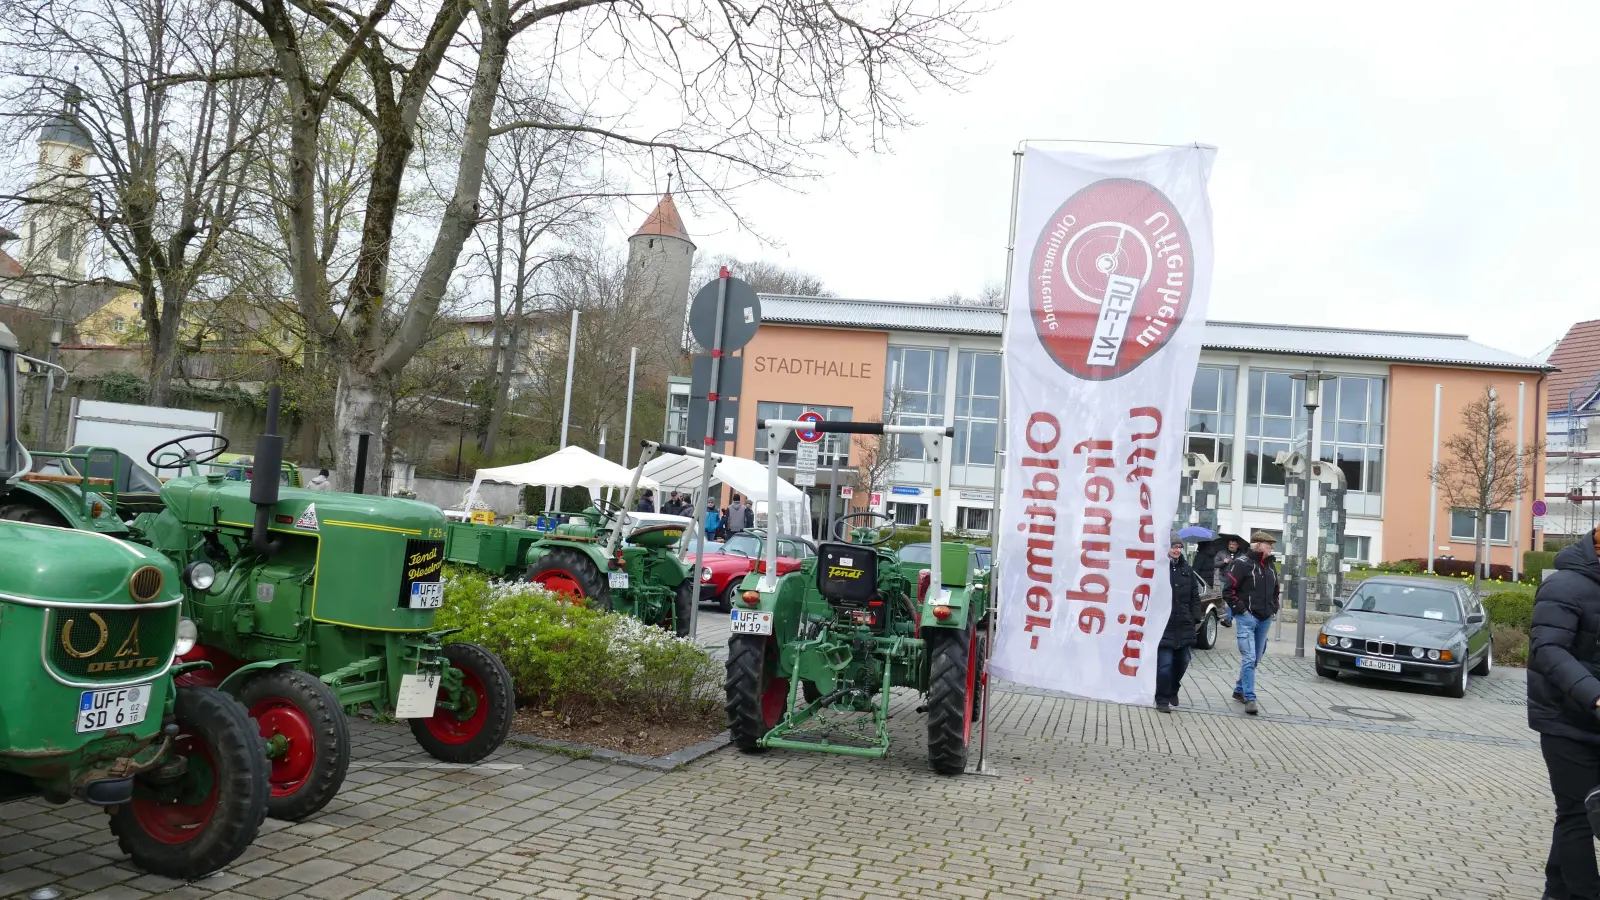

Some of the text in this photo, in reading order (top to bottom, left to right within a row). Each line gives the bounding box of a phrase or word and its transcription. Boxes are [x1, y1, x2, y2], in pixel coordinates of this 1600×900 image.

[754, 356, 872, 379] STADTHALLE
[408, 547, 438, 566] Fendt
[828, 566, 864, 579] Fendt
[420, 584, 437, 595] UFF
[420, 596, 439, 607] N 25
[740, 612, 758, 622] UFF
[734, 622, 761, 632] WM 19
[88, 657, 158, 673] DEUTZ
[94, 690, 127, 709] UFF
[131, 703, 140, 711] 02
[84, 708, 124, 729] SD 6
